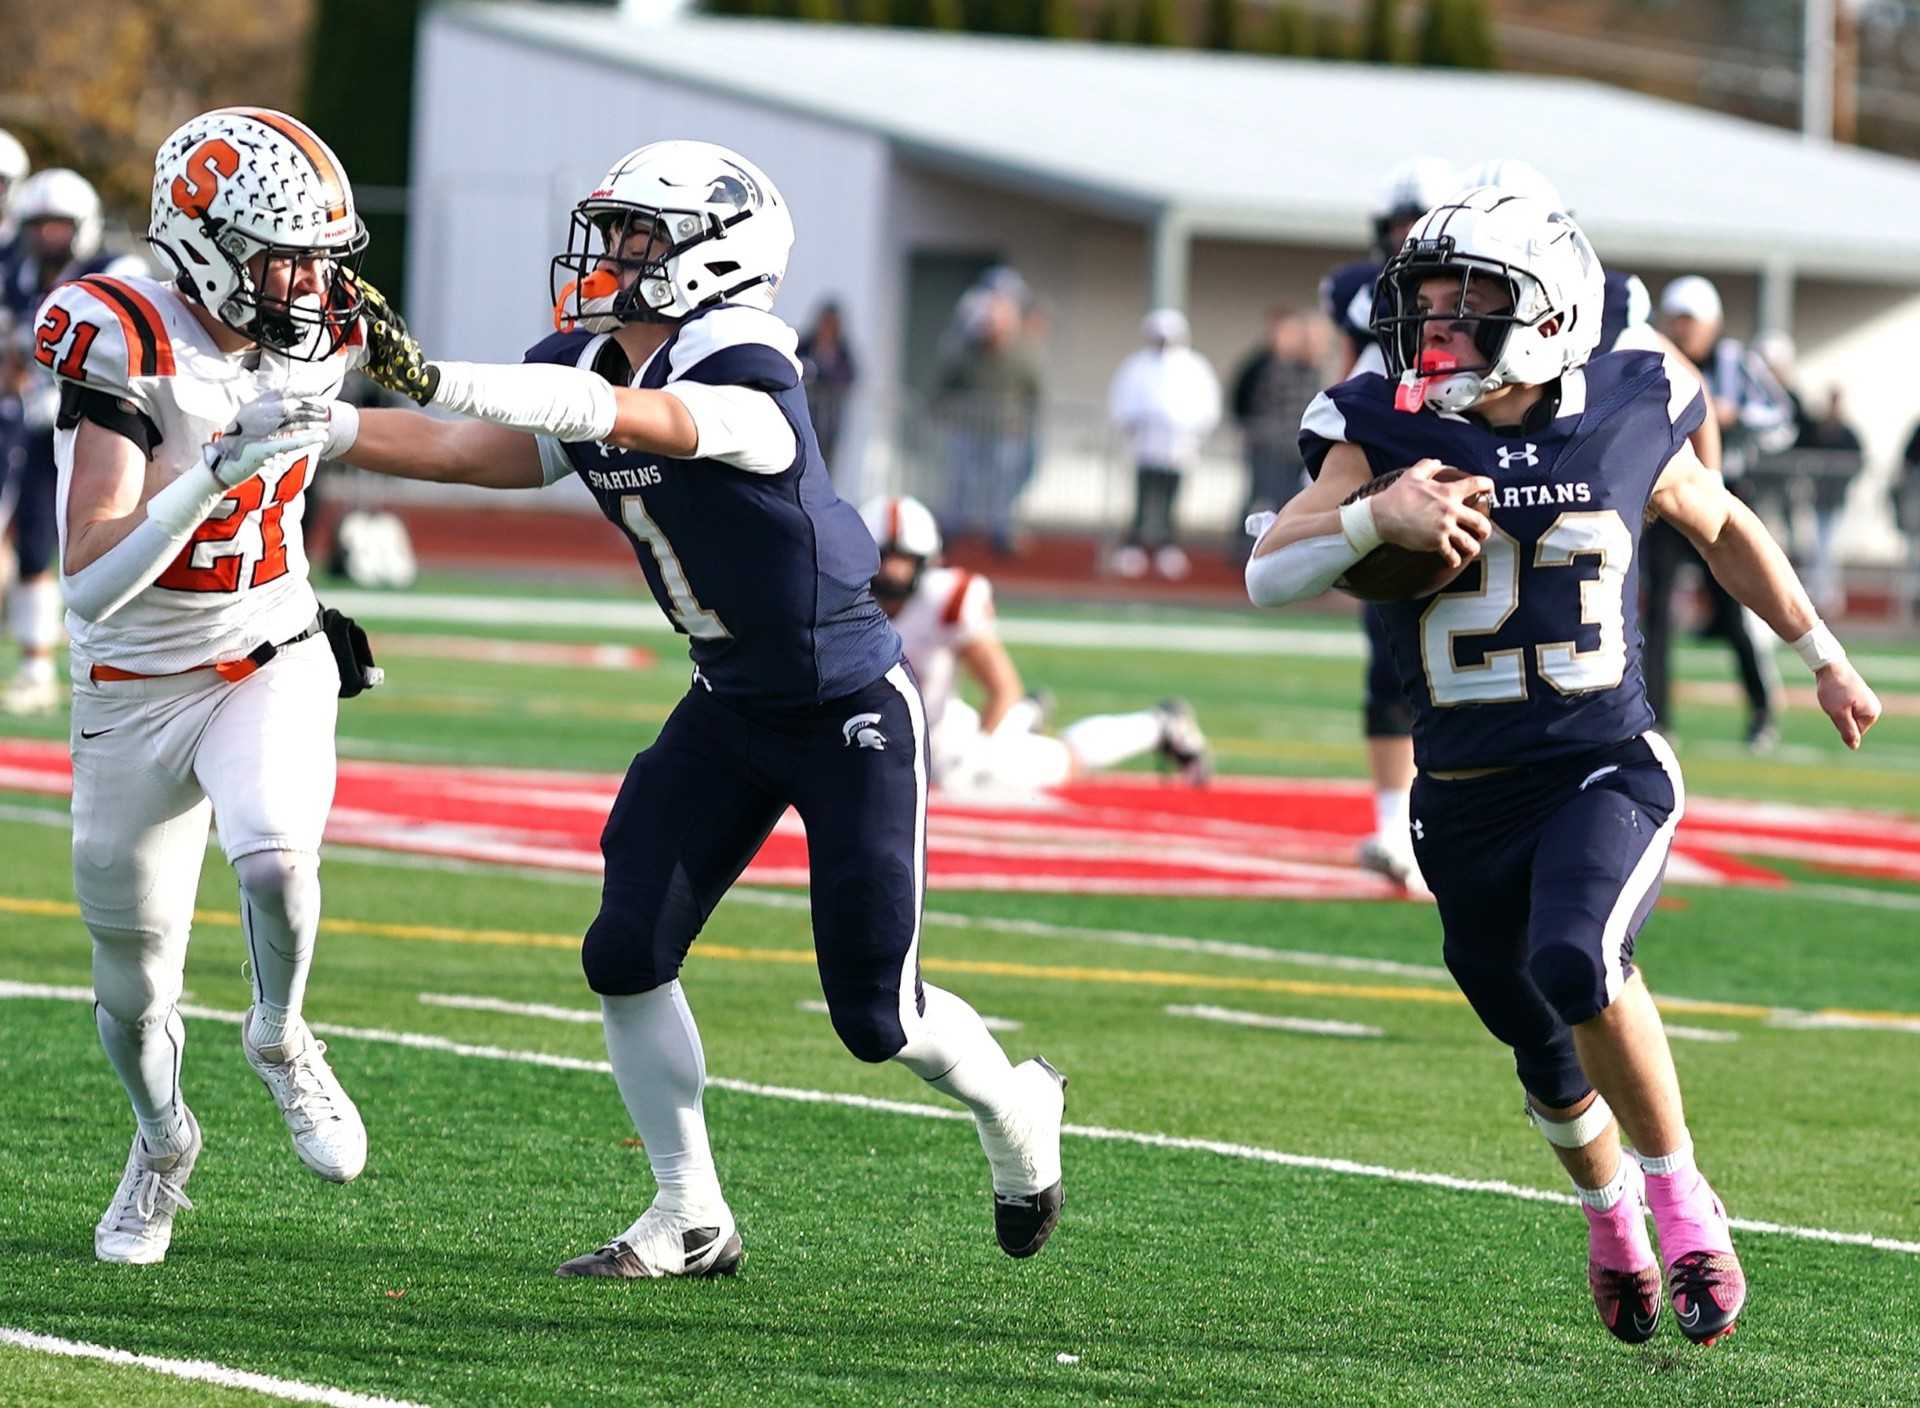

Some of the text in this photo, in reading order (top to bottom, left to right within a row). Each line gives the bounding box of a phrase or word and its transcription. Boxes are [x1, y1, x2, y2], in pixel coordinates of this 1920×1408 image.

[171, 138, 240, 219] S
[34, 304, 100, 382] 21
[588, 464, 662, 490] SPARTANS
[1486, 482, 1592, 508] ARTANS
[153, 455, 309, 593] 21
[622, 495, 734, 639] 1
[1420, 510, 1633, 707] 23
